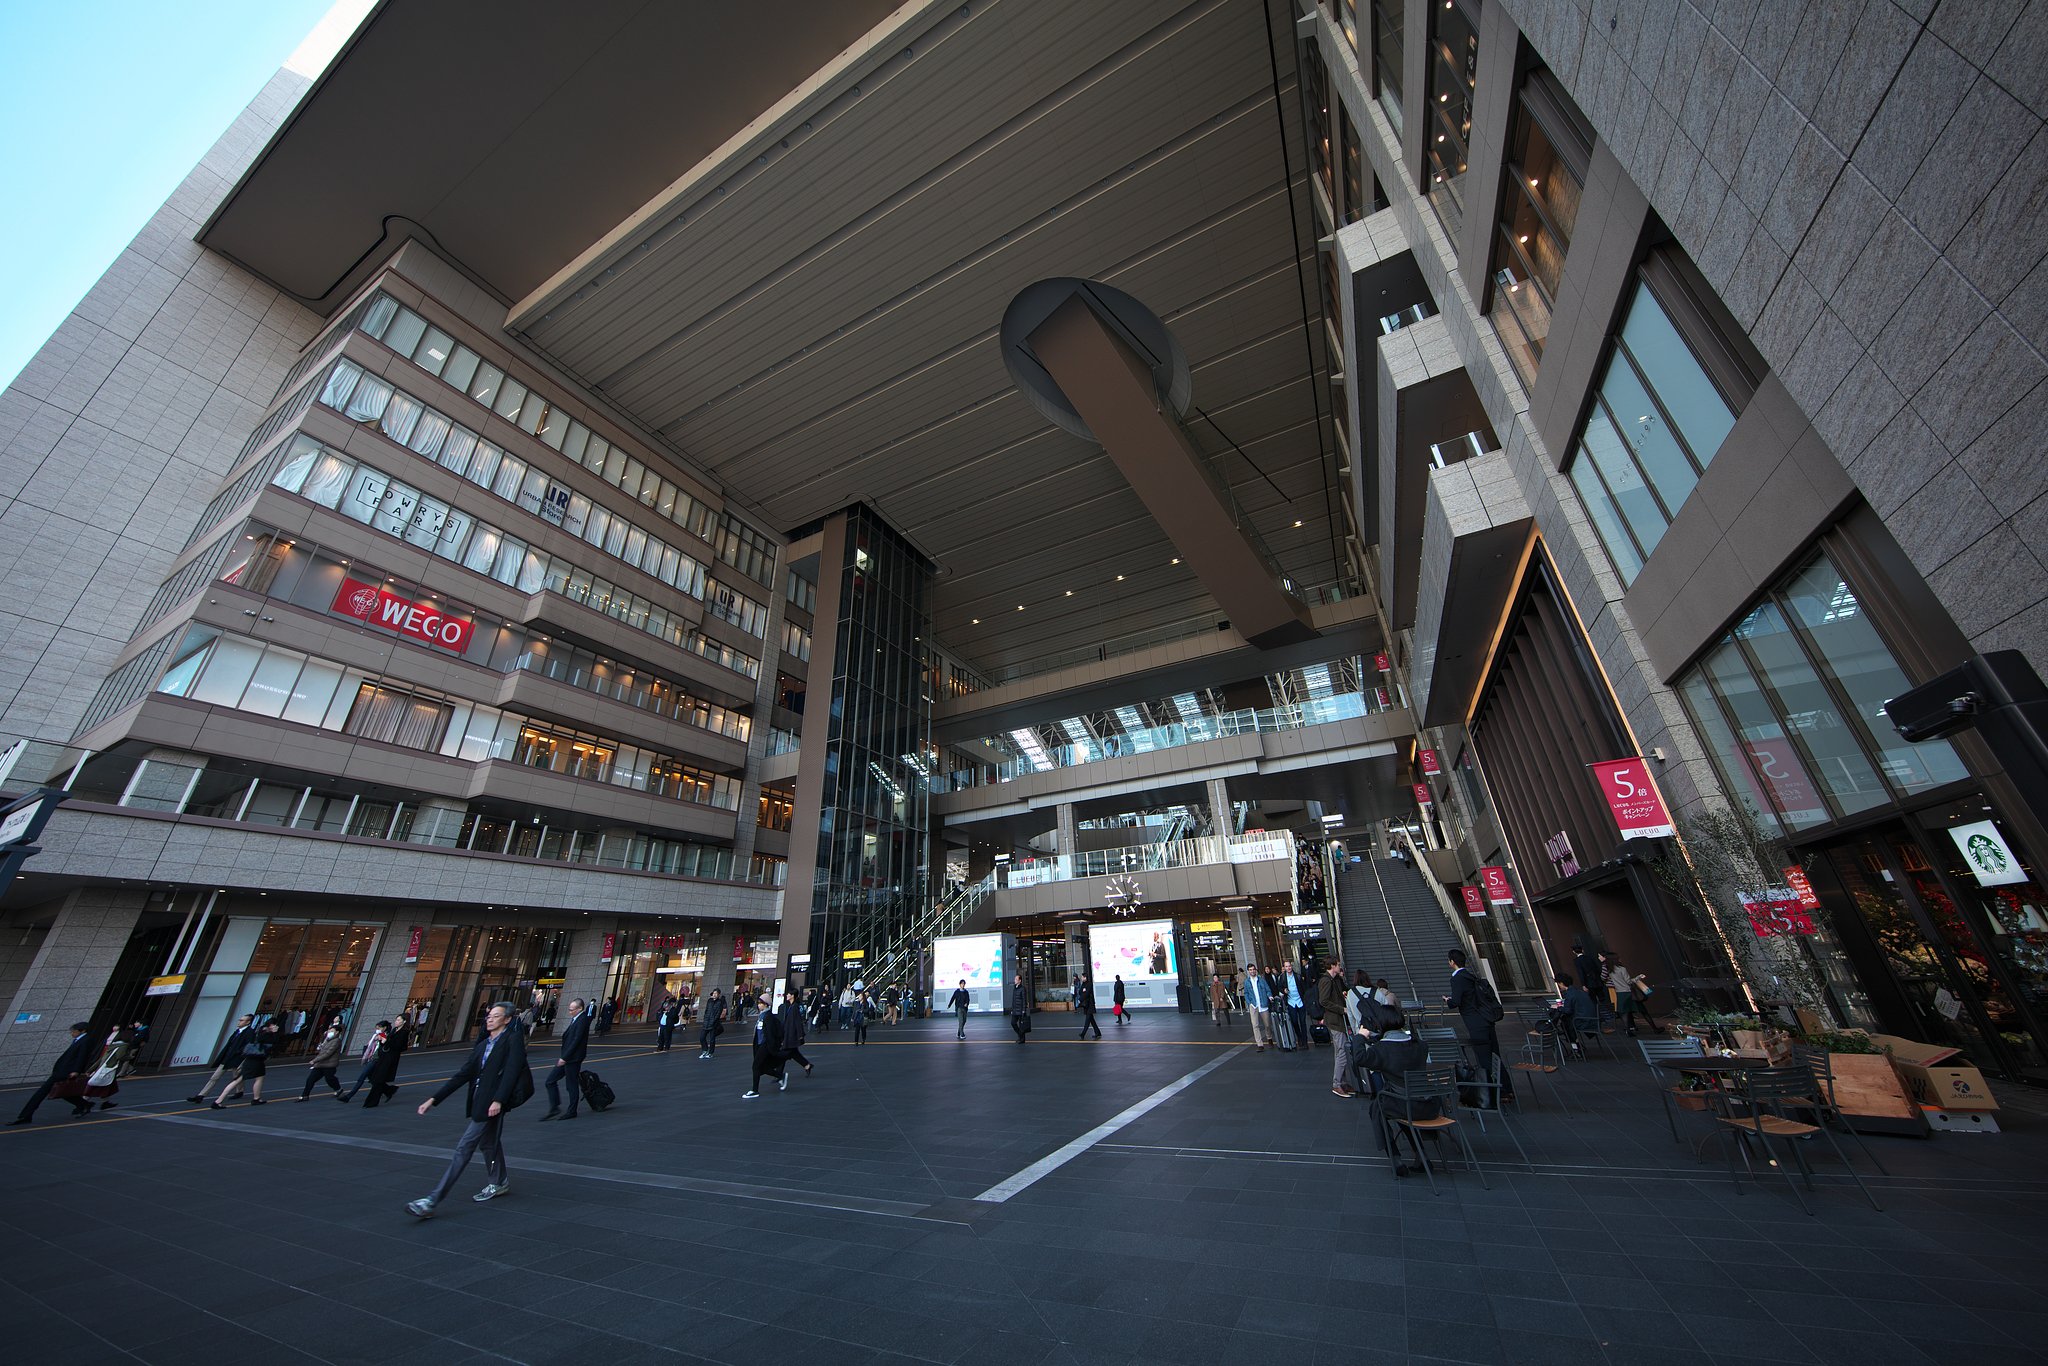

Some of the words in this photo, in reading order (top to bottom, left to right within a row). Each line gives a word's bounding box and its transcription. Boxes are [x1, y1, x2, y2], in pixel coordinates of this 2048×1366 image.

[368, 482, 454, 529] LOWRYS
[372, 497, 442, 533] FARM
[541, 506, 562, 521] Store
[381, 598, 462, 644] WEGO
[1622, 805, 1654, 815] ポイントアップ
[1624, 812, 1650, 820] キャンペーン
[172, 1054, 200, 1065] ucua
